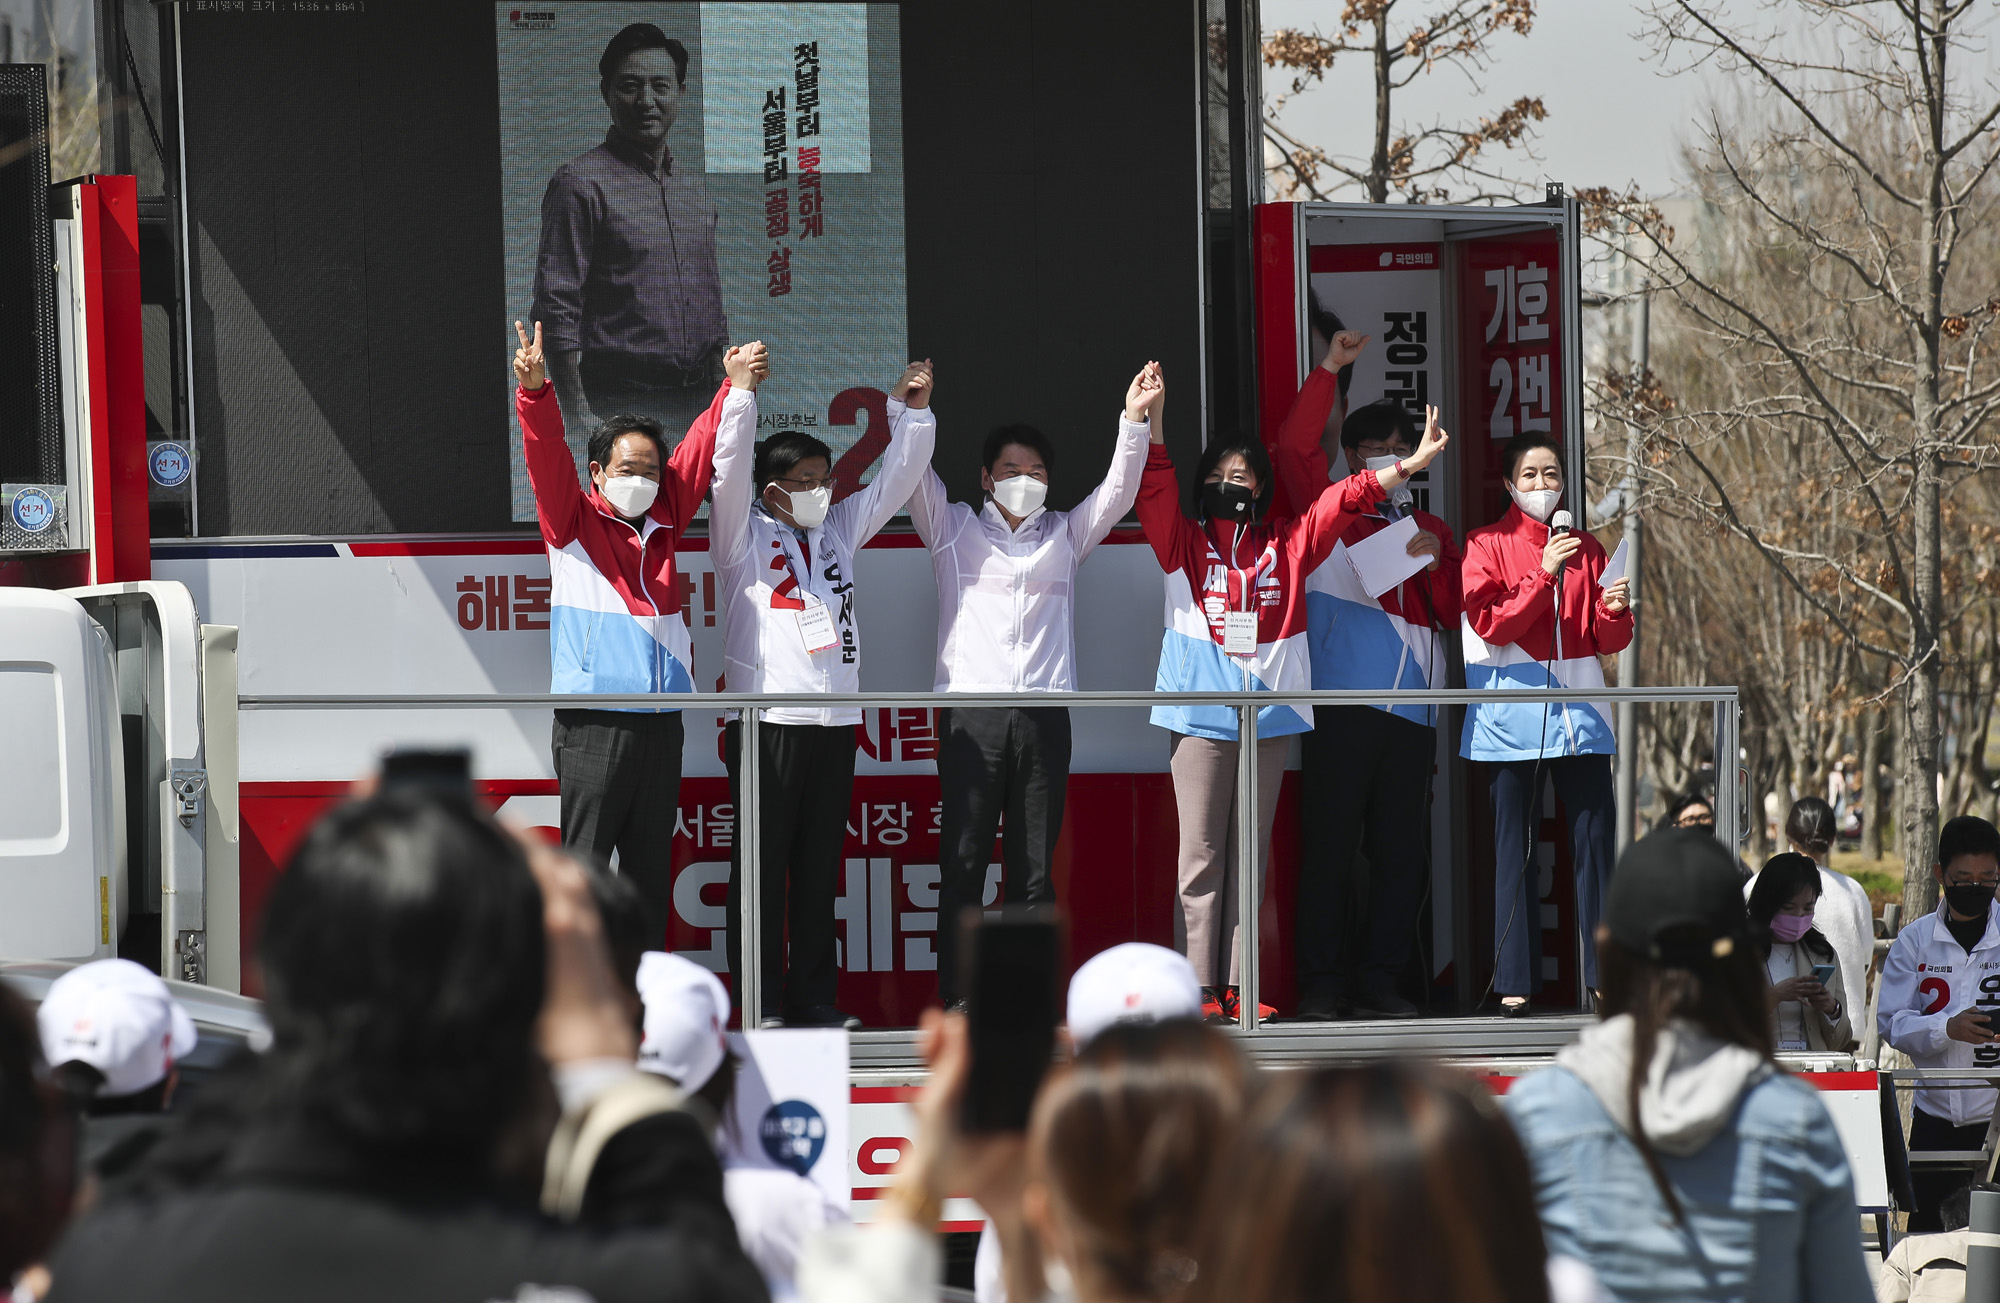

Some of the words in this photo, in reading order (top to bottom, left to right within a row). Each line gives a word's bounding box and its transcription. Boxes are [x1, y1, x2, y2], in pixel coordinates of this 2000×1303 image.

[794, 41, 820, 139] 첫날부터
[762, 85, 787, 184] 서울부터
[797, 146, 824, 242] 능숙하게
[1395, 252, 1433, 265] 국민의힘
[1485, 261, 1550, 344] 기호
[1489, 354, 1551, 440] 2번
[157, 458, 180, 472] 선거
[828, 386, 892, 505] 2
[20, 503, 44, 517] 선거
[769, 553, 806, 611] 2
[1257, 546, 1281, 588] 2
[1920, 976, 1951, 1016] 2
[1927, 965, 1953, 974] 국민의힘
